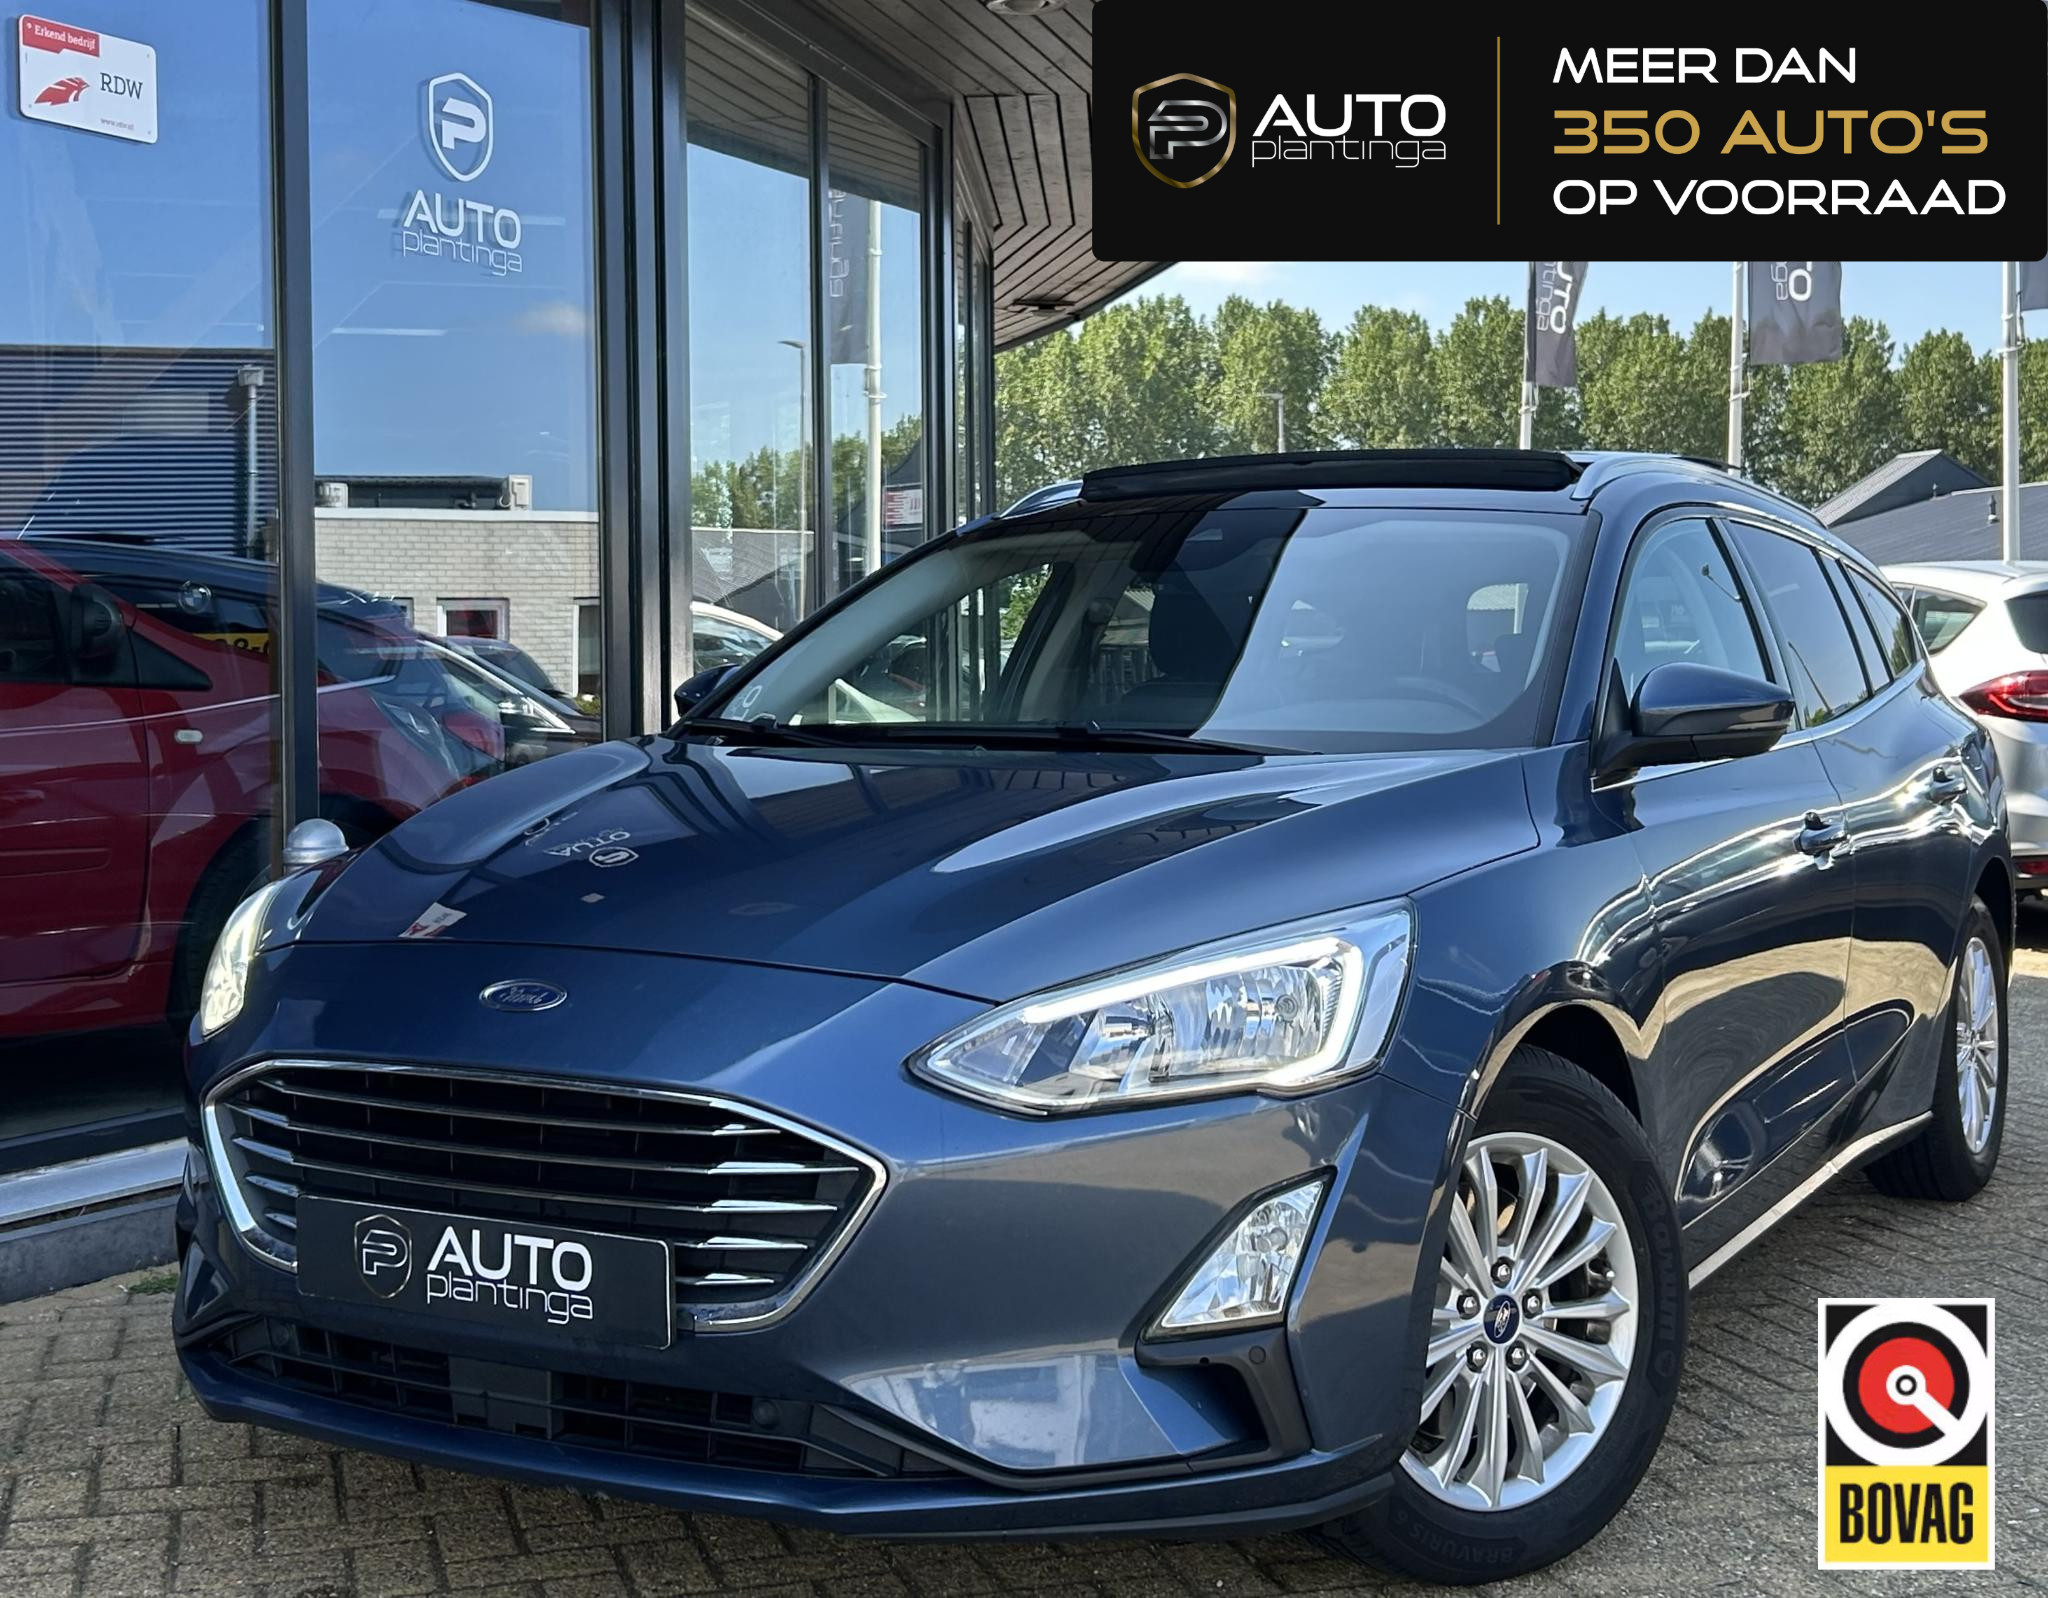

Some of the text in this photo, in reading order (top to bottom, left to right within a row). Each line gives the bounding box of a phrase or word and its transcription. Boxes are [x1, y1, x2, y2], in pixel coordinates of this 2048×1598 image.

[34, 24, 96, 51] Erkend bedrijf
[100, 72, 143, 100] RDW
[403, 189, 522, 249] AUTO
[402, 229, 523, 277] plantinga
[1549, 262, 1573, 335] UTO
[426, 1225, 593, 1292] AUTO
[426, 1271, 594, 1325] plantinga
